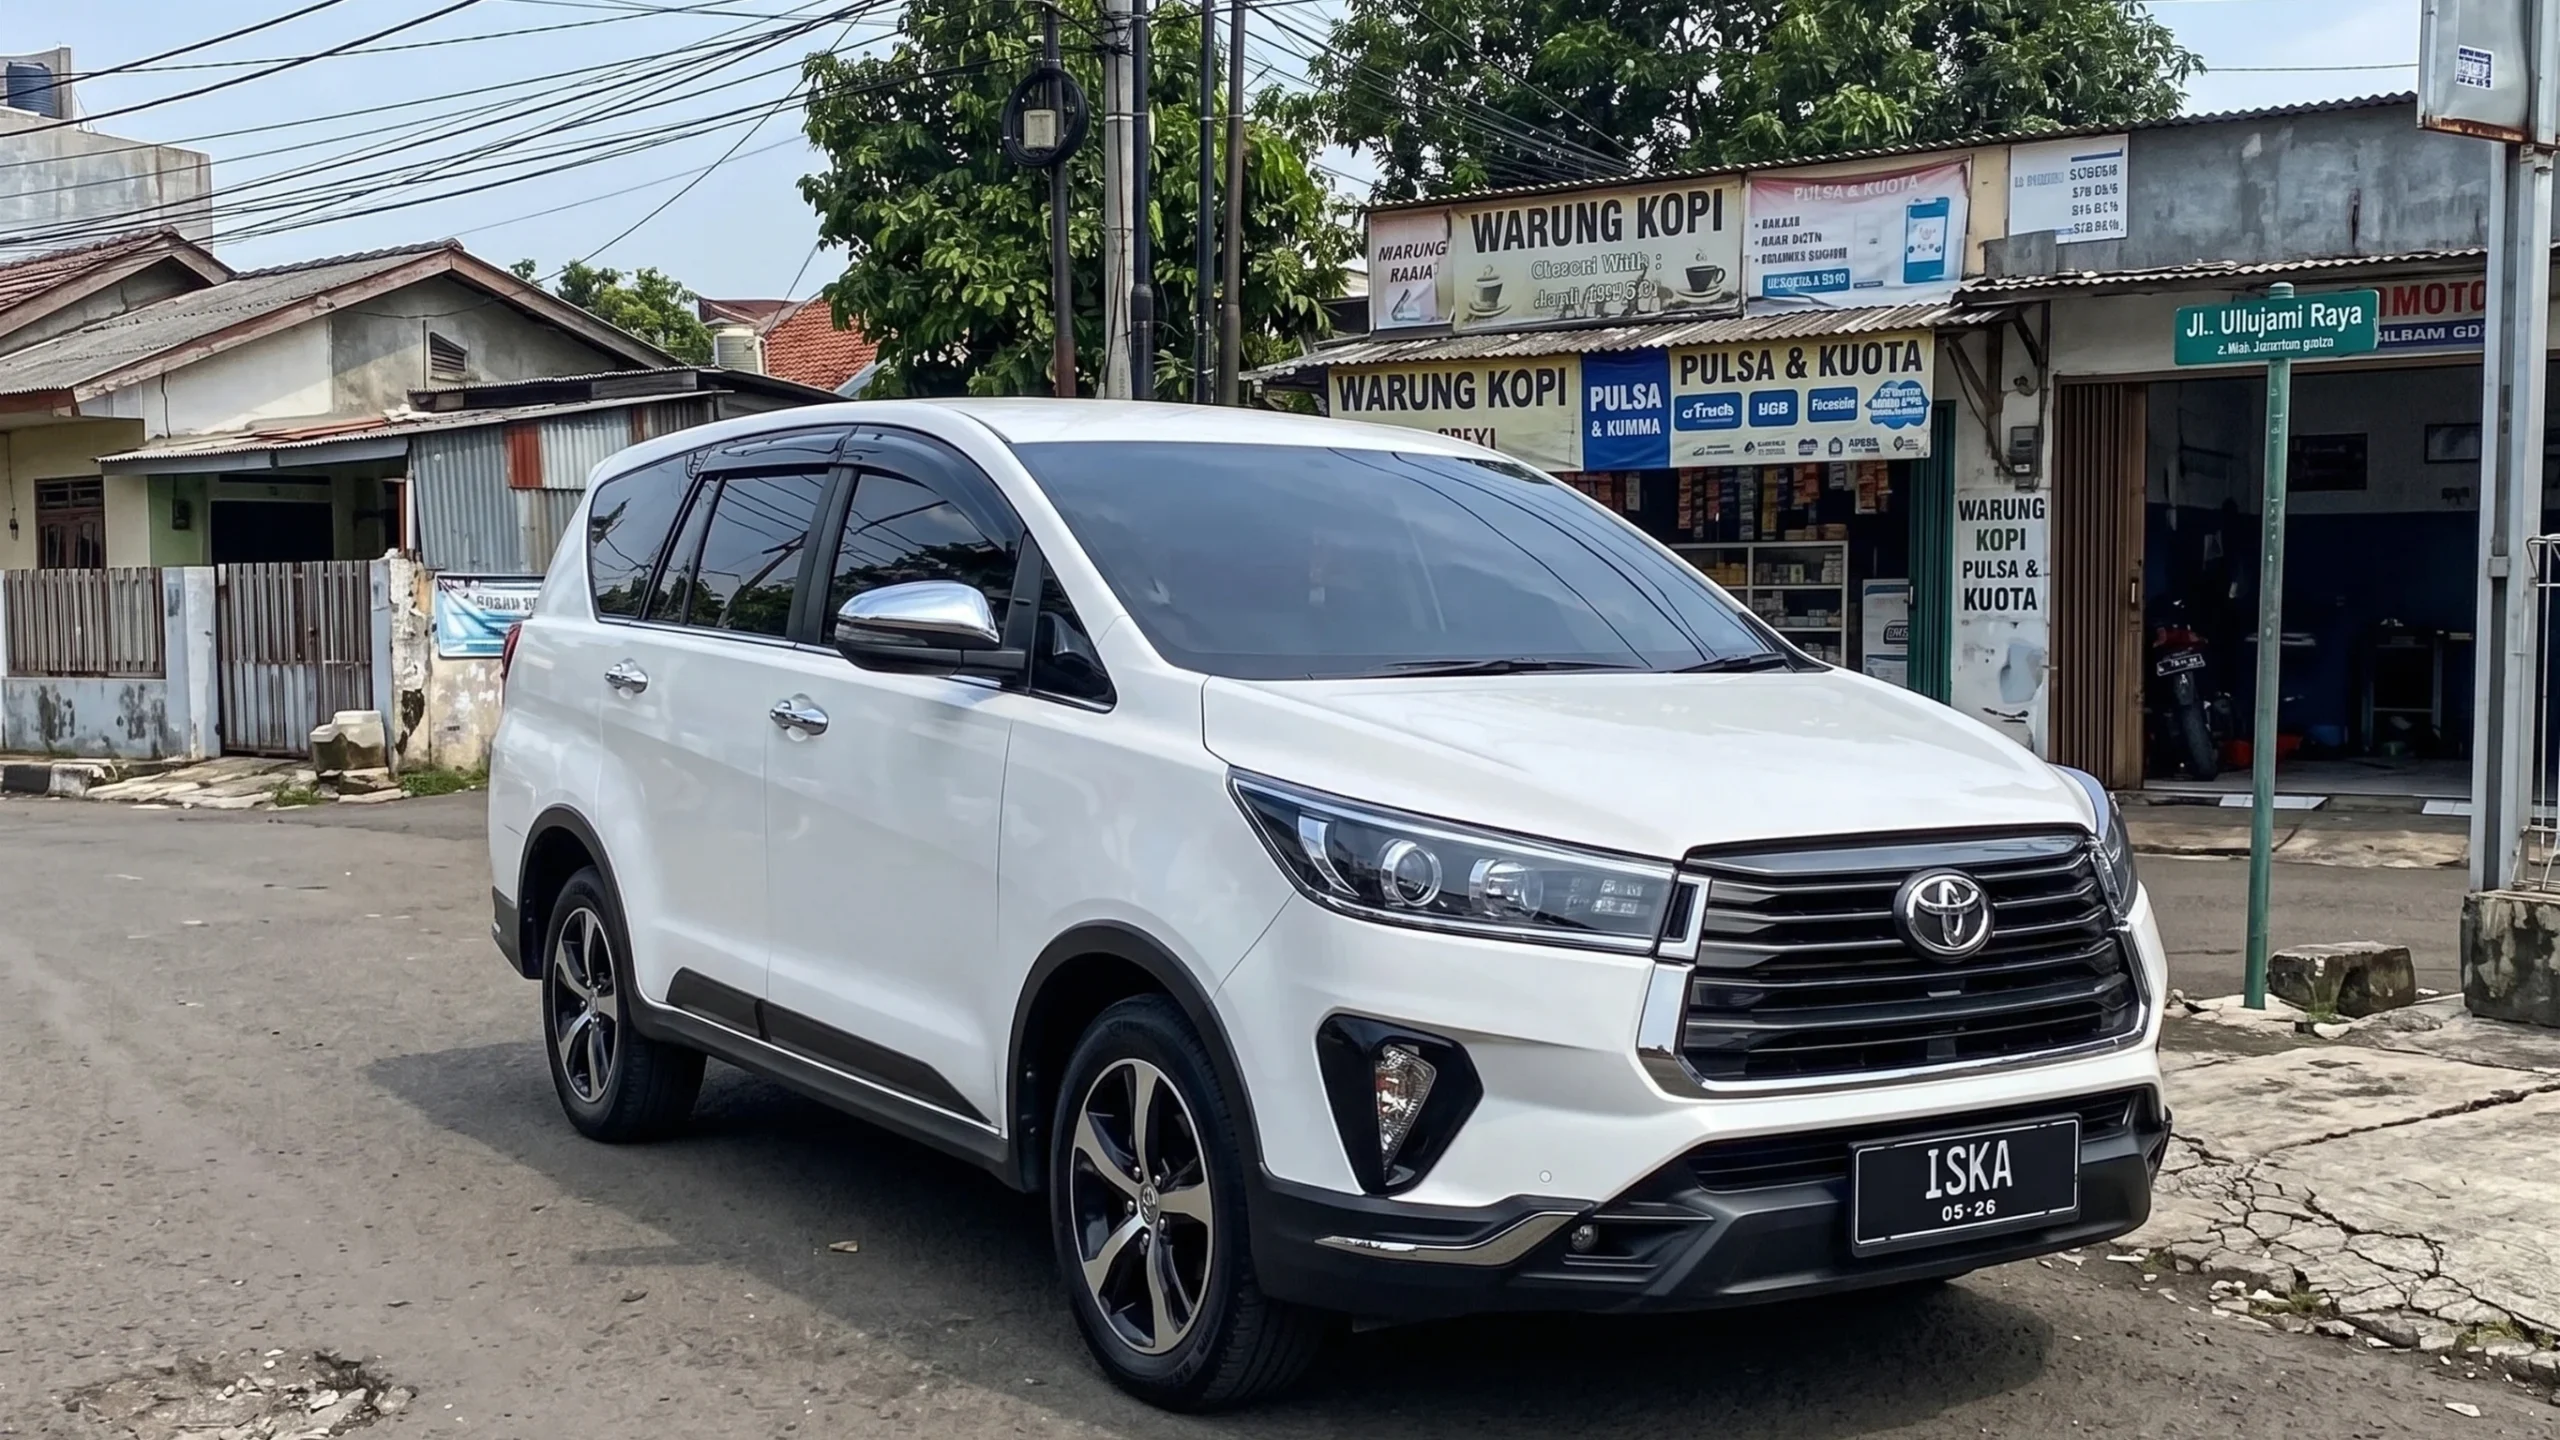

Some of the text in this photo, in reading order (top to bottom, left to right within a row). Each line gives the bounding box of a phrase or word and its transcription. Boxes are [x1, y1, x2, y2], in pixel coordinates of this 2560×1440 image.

[1864, 175, 1919, 196] KUOTA
[1471, 189, 1722, 254] WARUNG KOPI
[2220, 304, 2303, 338] Ullujami
[2311, 303, 2362, 332] Raya
[1680, 339, 1923, 386] PULSA & KUOTA
[1337, 367, 1566, 412] WARUNG KOPI
[1590, 383, 1662, 412] PULSA
[1591, 418, 1661, 438] & KUMMA
[1959, 497, 2045, 521] WARUNG
[1976, 528, 2026, 551] KOPI
[1963, 559, 2038, 579] PULSA &
[1964, 587, 2038, 611] KUOTA
[1925, 1139, 2013, 1199] ISKA
